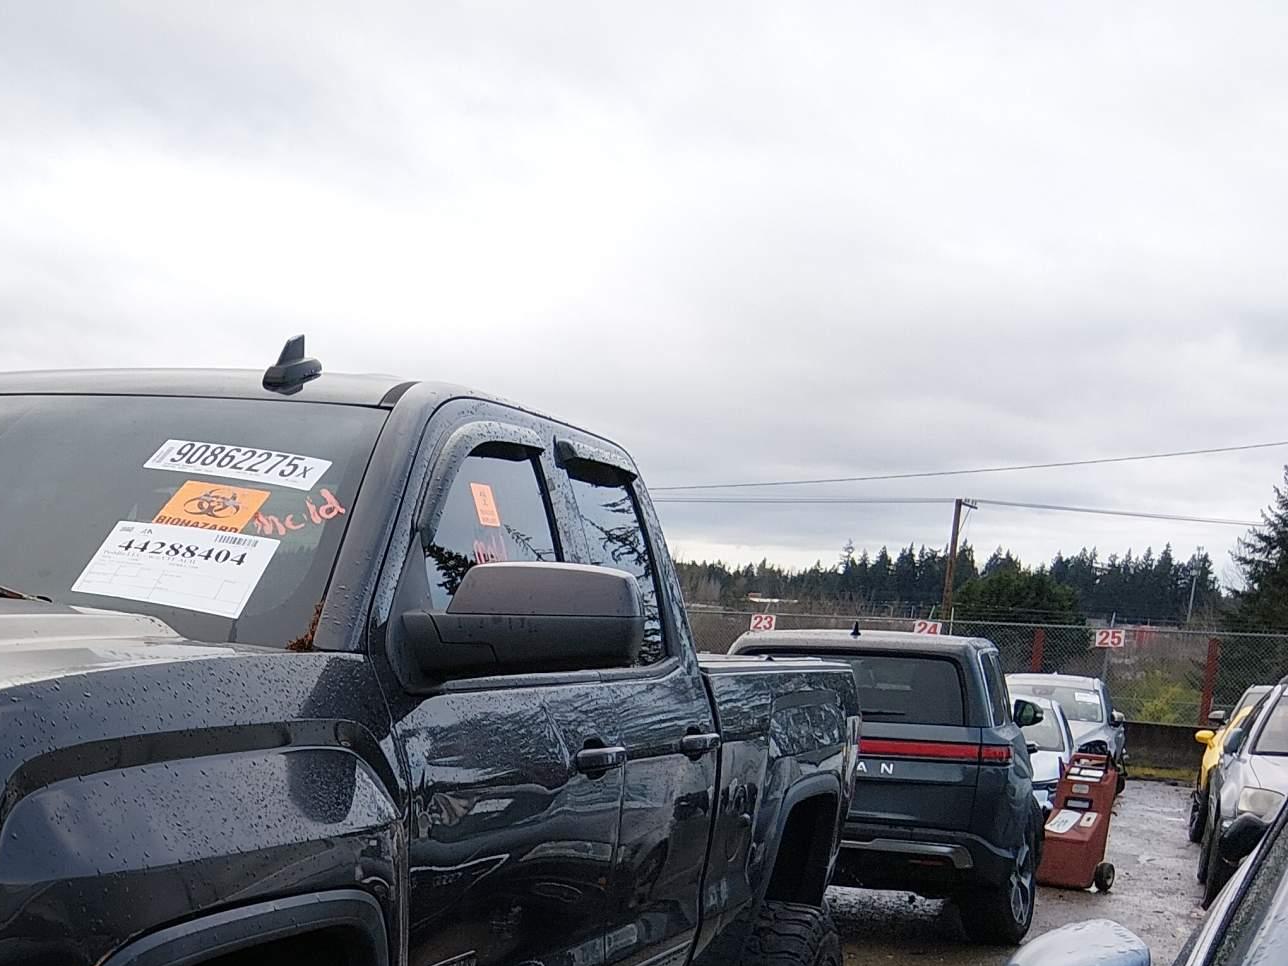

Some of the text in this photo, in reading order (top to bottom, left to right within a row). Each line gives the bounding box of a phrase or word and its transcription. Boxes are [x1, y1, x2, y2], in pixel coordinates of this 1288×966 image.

[118, 538, 248, 566] 44288404
[752, 615, 774, 630] 23
[918, 621, 938, 634] 24
[1098, 630, 1122, 646] 25
